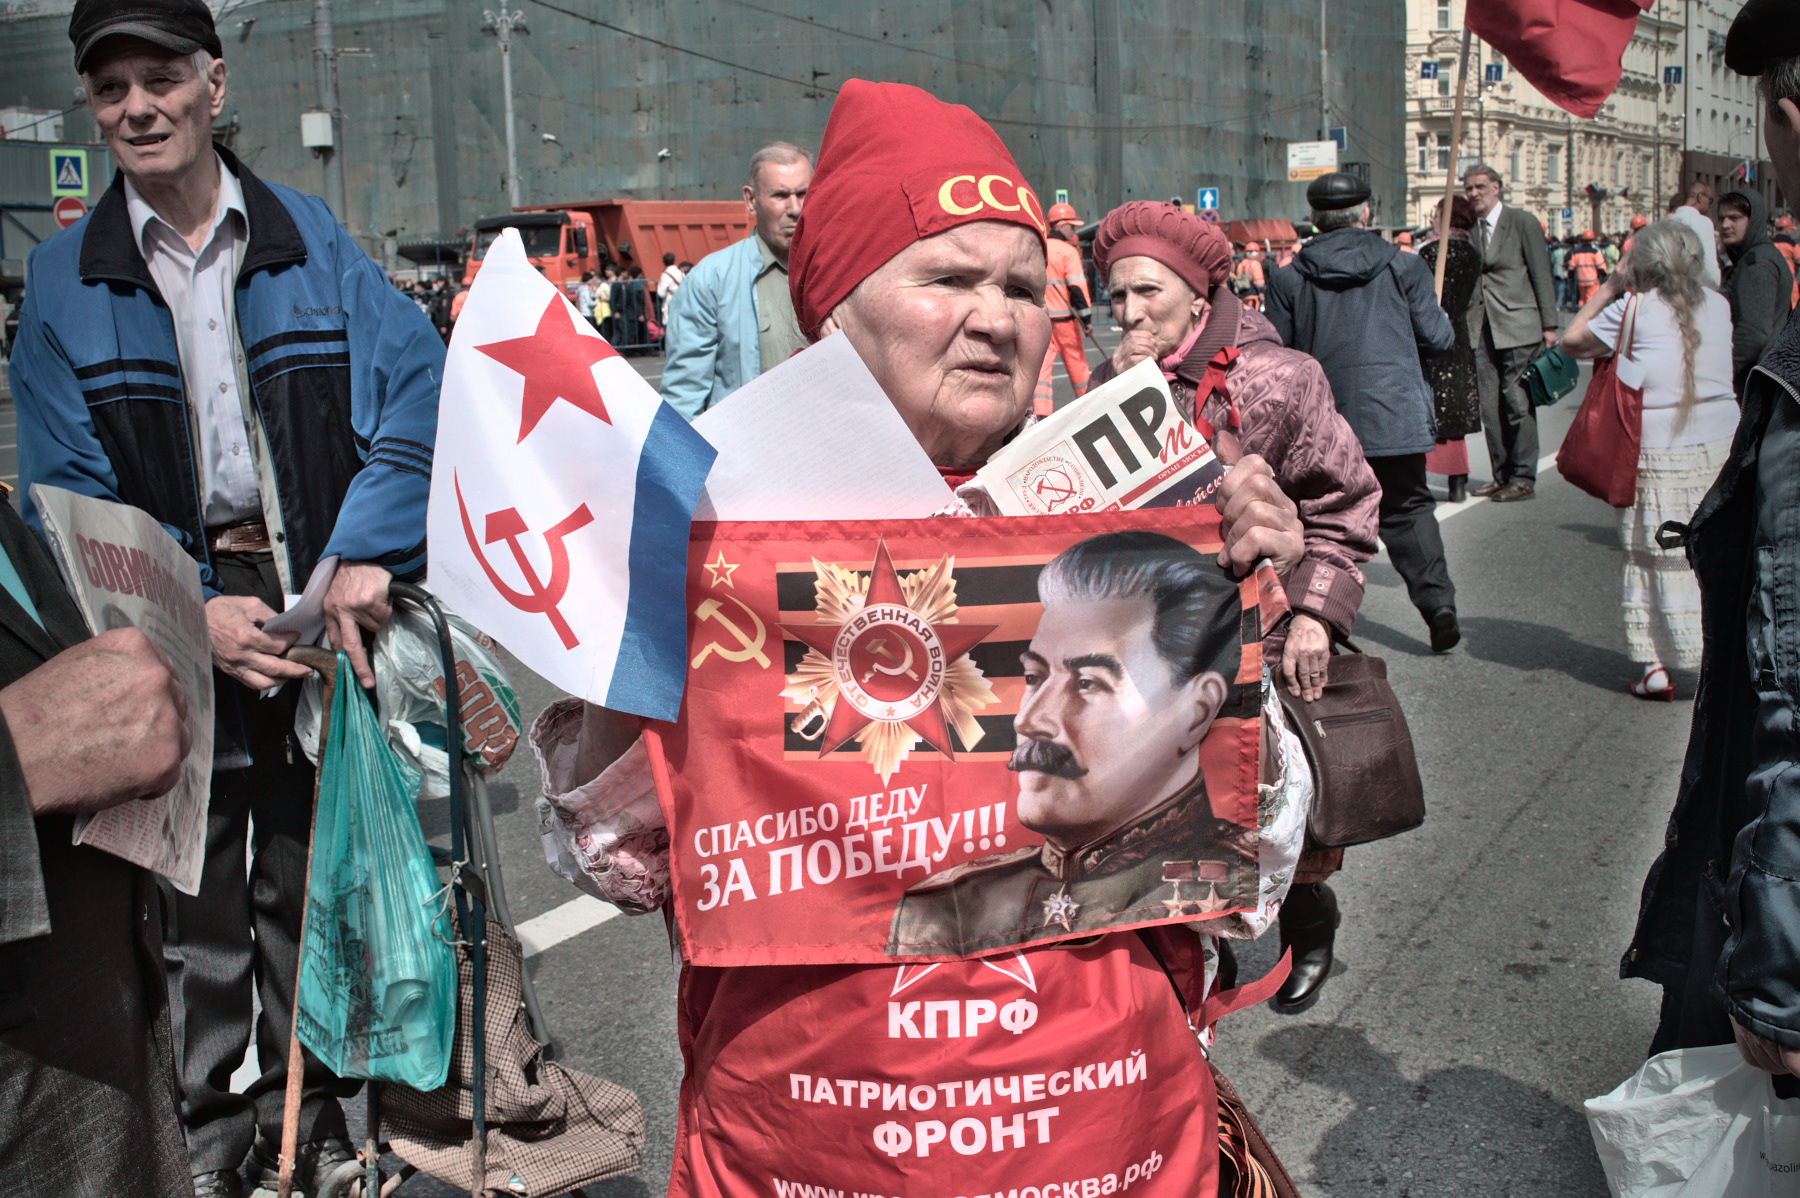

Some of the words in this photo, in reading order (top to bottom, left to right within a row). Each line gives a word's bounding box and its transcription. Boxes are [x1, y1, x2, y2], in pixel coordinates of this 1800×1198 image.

[938, 174, 1047, 240] ССС
[1072, 386, 1168, 490] ПР
[1158, 463, 1180, 480] ОРГАН
[1060, 497, 1096, 515] РФ
[836, 608, 934, 708] ОТЕЧЕСТВЕННАЯ
[694, 802, 839, 858] СПАСИБО
[845, 784, 928, 834] ДЕДУ
[696, 857, 758, 912] ЗА
[767, 801, 1007, 897] ПОБЕДУ!!!
[887, 998, 1039, 1039] КПРФ
[789, 1048, 1148, 1111] ПАТРИОТИЧЕСКИЙ
[873, 1106, 1060, 1158] ФРОНТ
